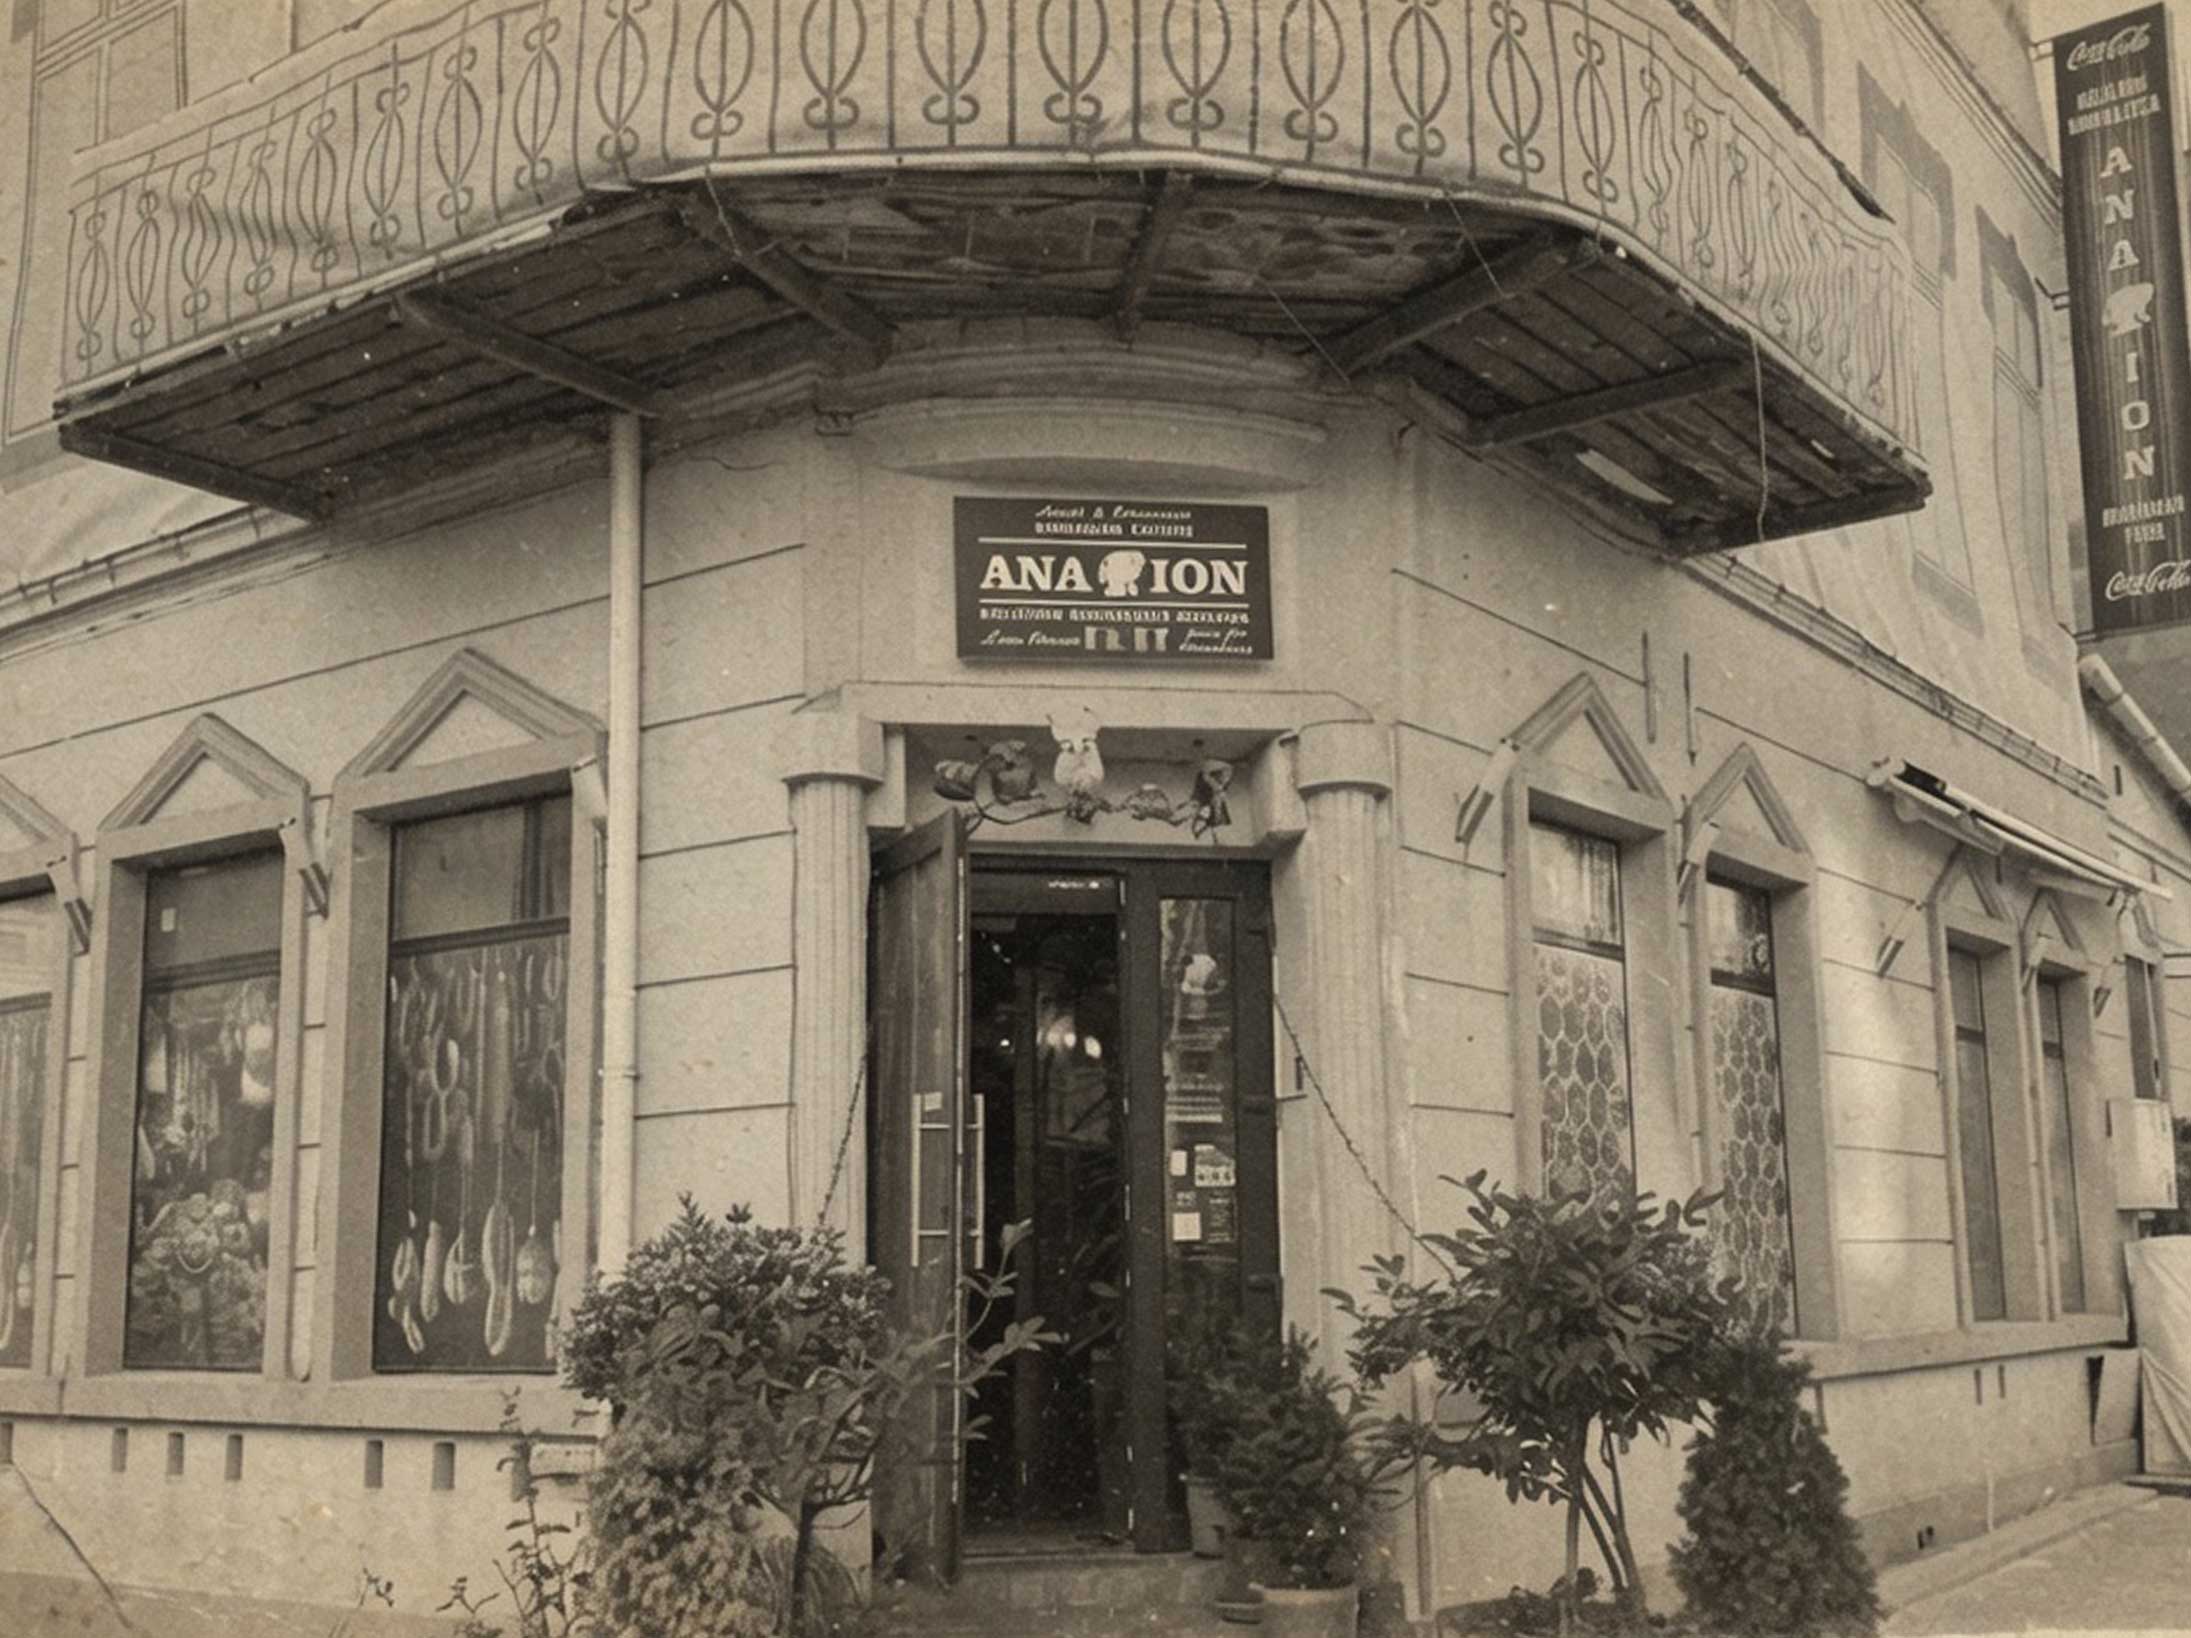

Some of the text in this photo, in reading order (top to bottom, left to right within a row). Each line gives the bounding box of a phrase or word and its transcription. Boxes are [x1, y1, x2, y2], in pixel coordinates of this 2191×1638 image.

[2100, 146, 2139, 271] ANA
[2120, 352, 2154, 480] ION
[979, 554, 1249, 595] ANA ION
